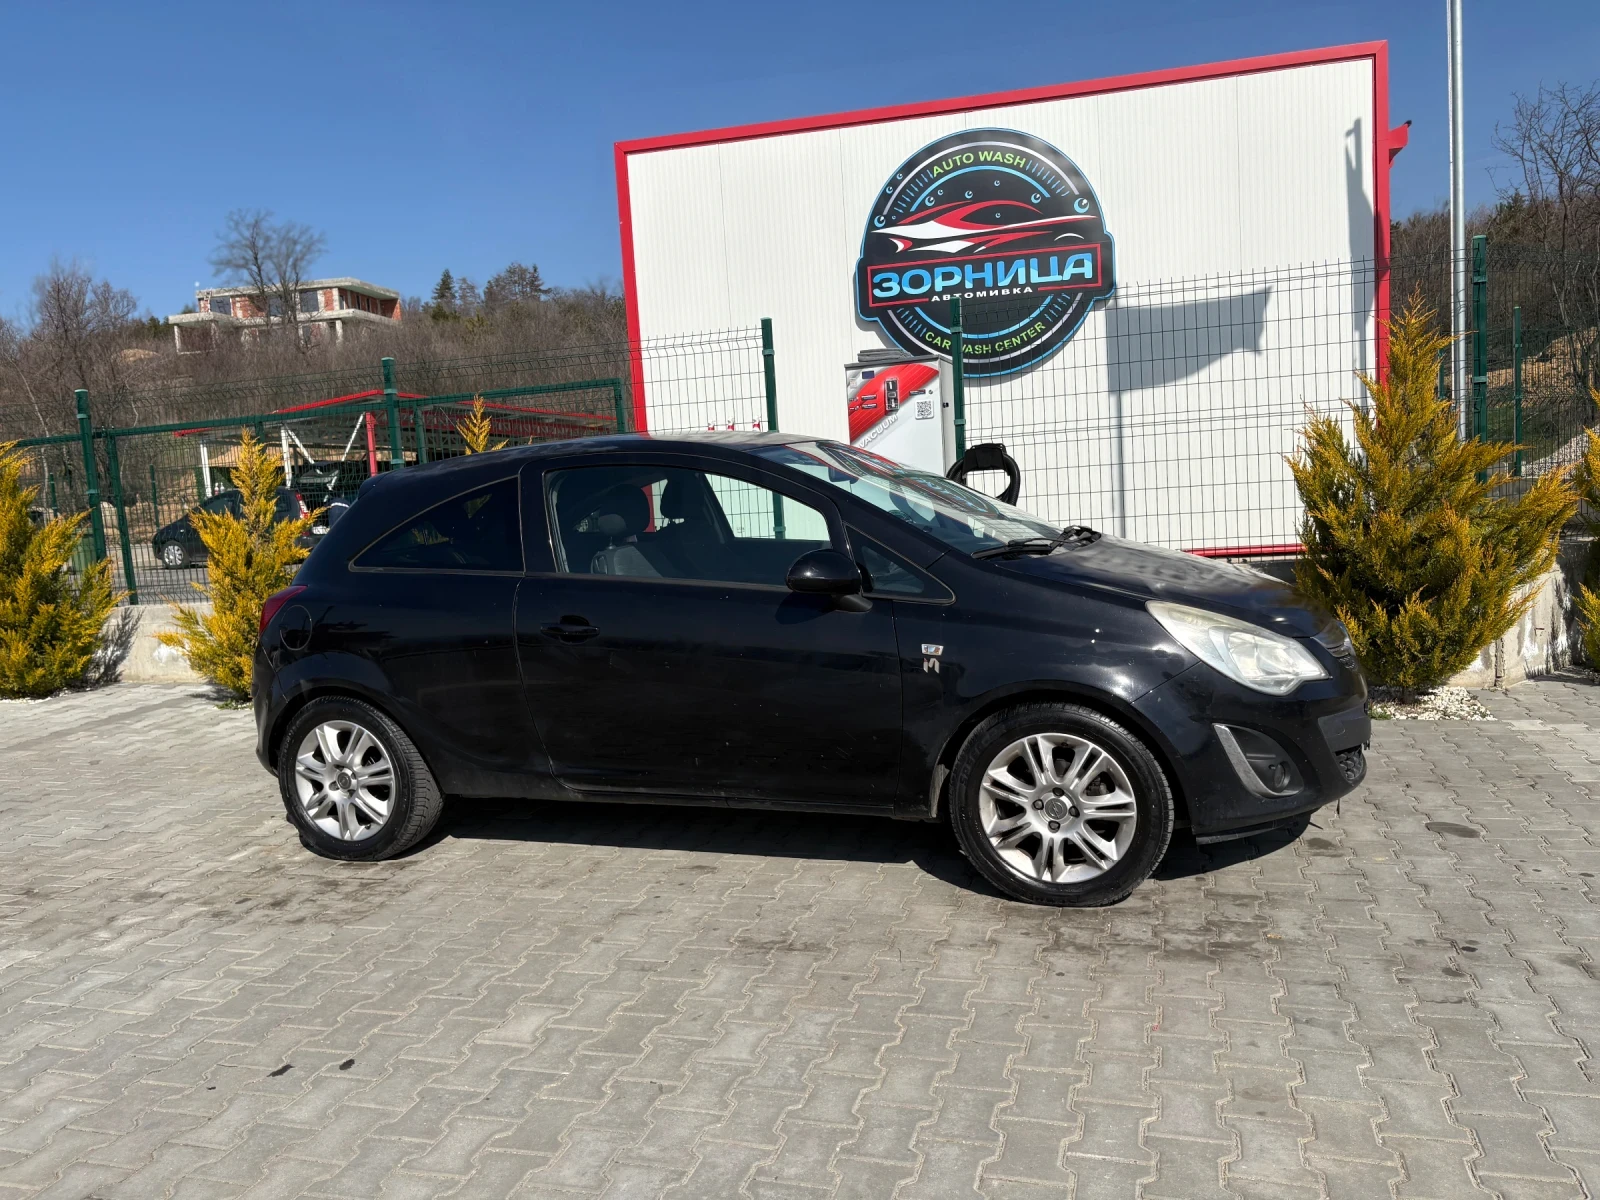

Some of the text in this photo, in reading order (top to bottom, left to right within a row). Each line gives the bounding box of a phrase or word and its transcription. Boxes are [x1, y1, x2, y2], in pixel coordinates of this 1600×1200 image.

[933, 150, 1026, 177] AUTO WASH
[872, 252, 1093, 298] ЗОРНИЦА
[931, 286, 1033, 302] АВТОМИВКА
[925, 331, 951, 350] CAR
[995, 321, 1046, 352] CENTER
[859, 413, 898, 448] VACUUM
